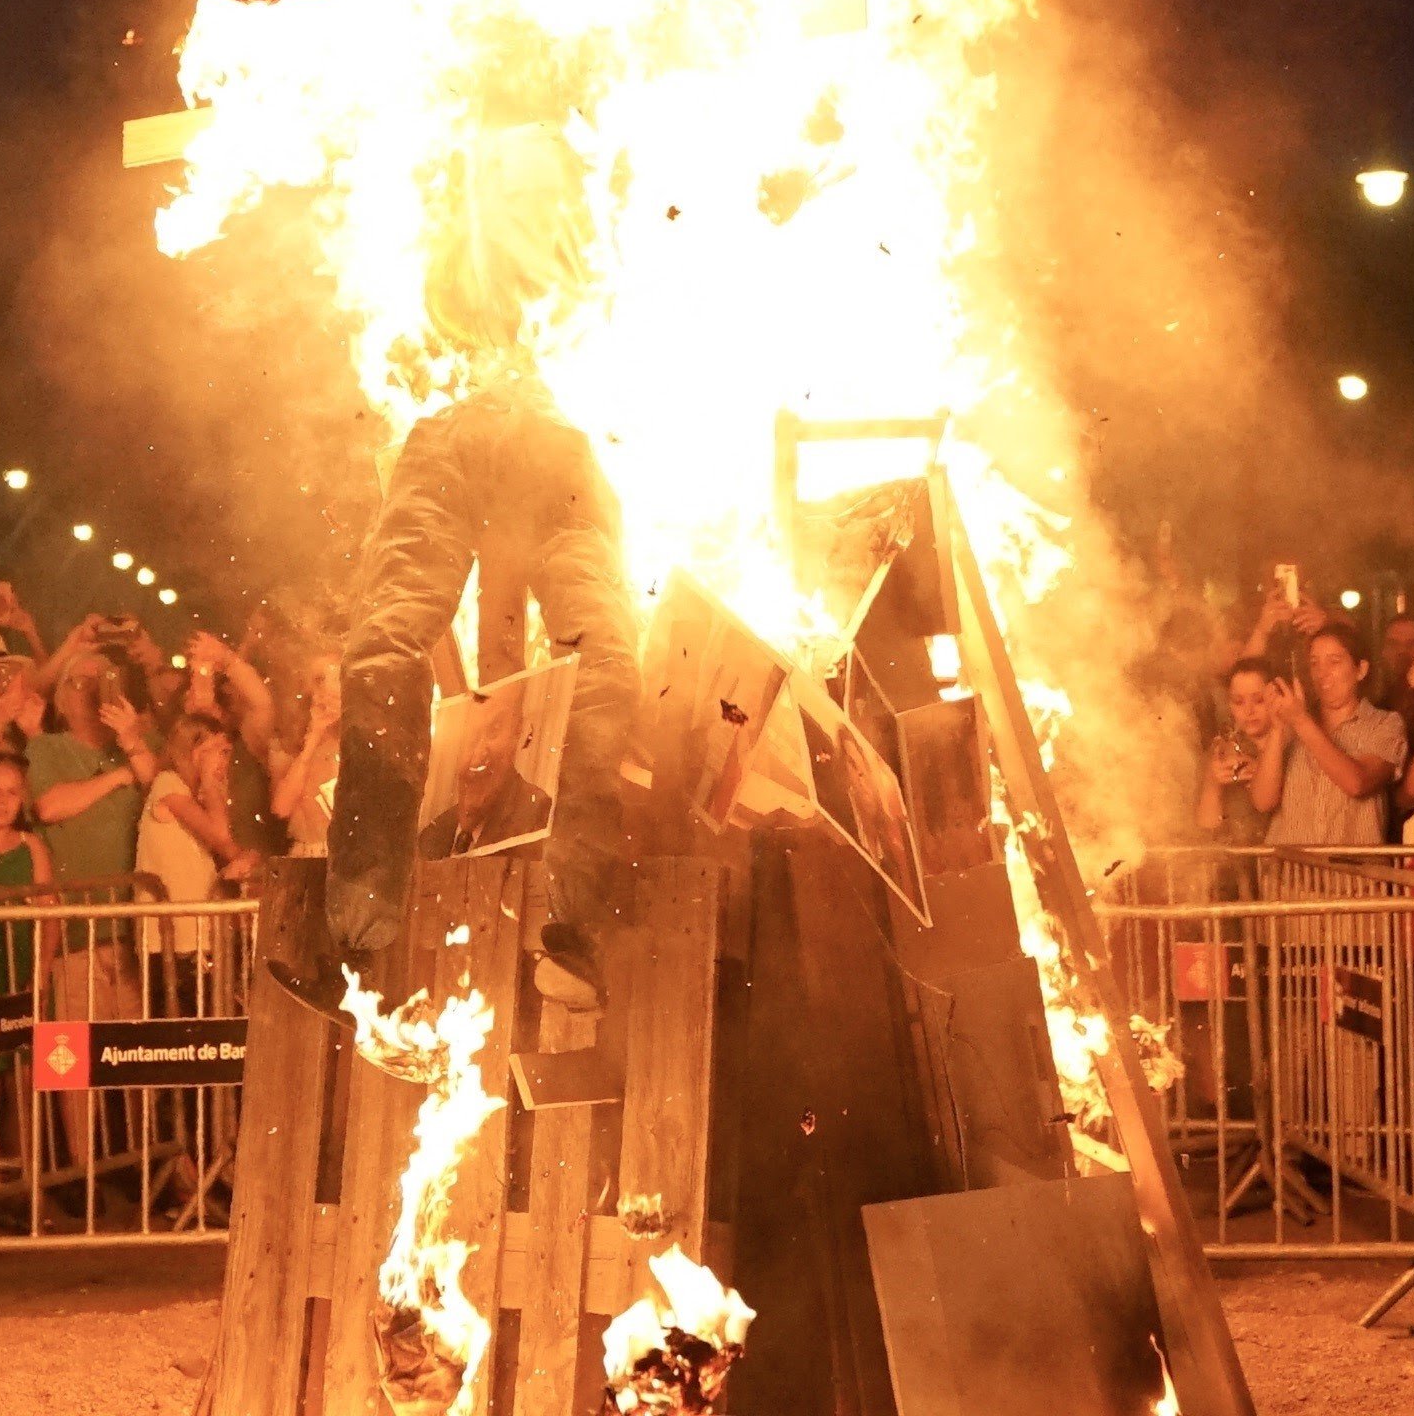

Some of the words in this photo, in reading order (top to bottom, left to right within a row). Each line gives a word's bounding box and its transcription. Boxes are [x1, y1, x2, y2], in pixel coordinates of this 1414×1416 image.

[100, 1044, 195, 1065] Ajuntament
[198, 1042, 217, 1061] de
[219, 1042, 247, 1061] Bar
